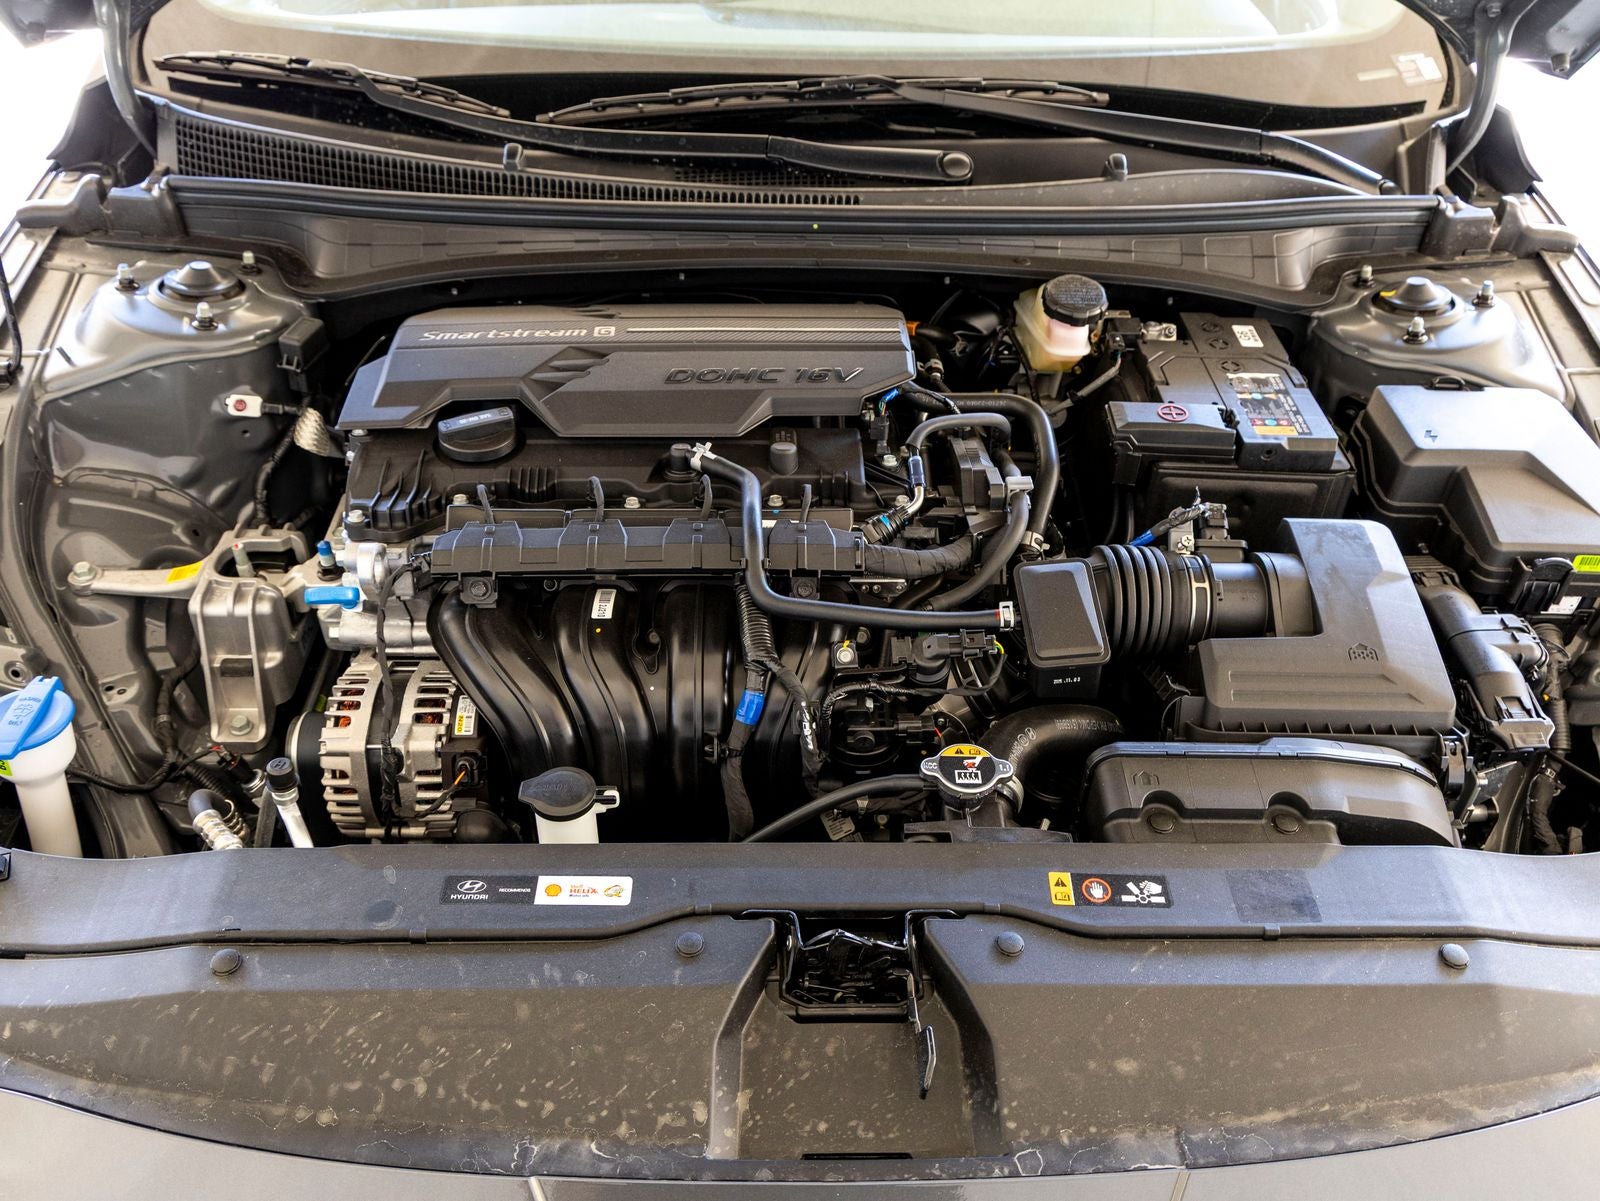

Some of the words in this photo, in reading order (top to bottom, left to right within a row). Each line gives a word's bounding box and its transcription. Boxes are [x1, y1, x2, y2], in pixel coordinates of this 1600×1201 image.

[419, 328, 588, 342] Smartstream
[664, 367, 786, 385] DOHC
[795, 366, 865, 384] 16V
